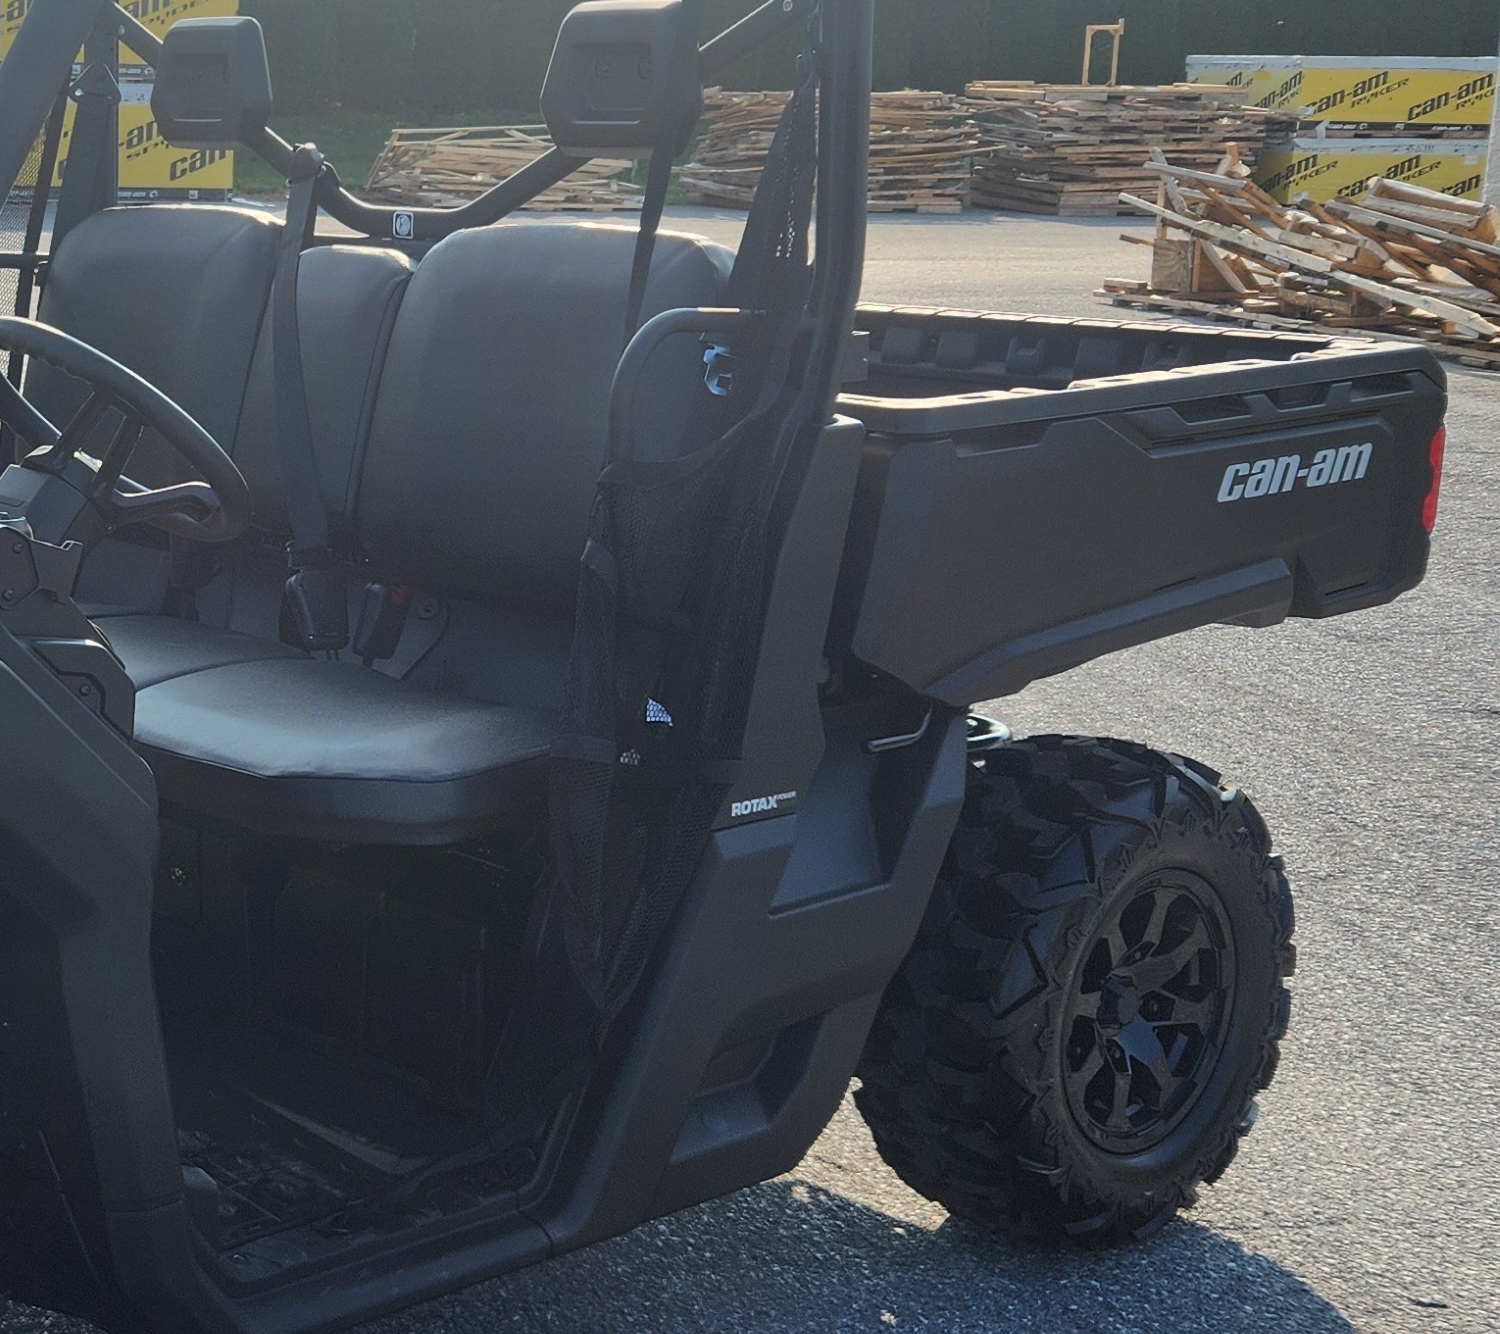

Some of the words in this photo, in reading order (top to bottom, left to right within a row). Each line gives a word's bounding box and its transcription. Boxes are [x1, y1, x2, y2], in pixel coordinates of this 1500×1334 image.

[1351, 77, 1409, 108] RYKER
[1408, 73, 1494, 121] can-am
[170, 150, 226, 181] can
[1217, 442, 1373, 503] can-am
[731, 795, 778, 817] ROTAX
